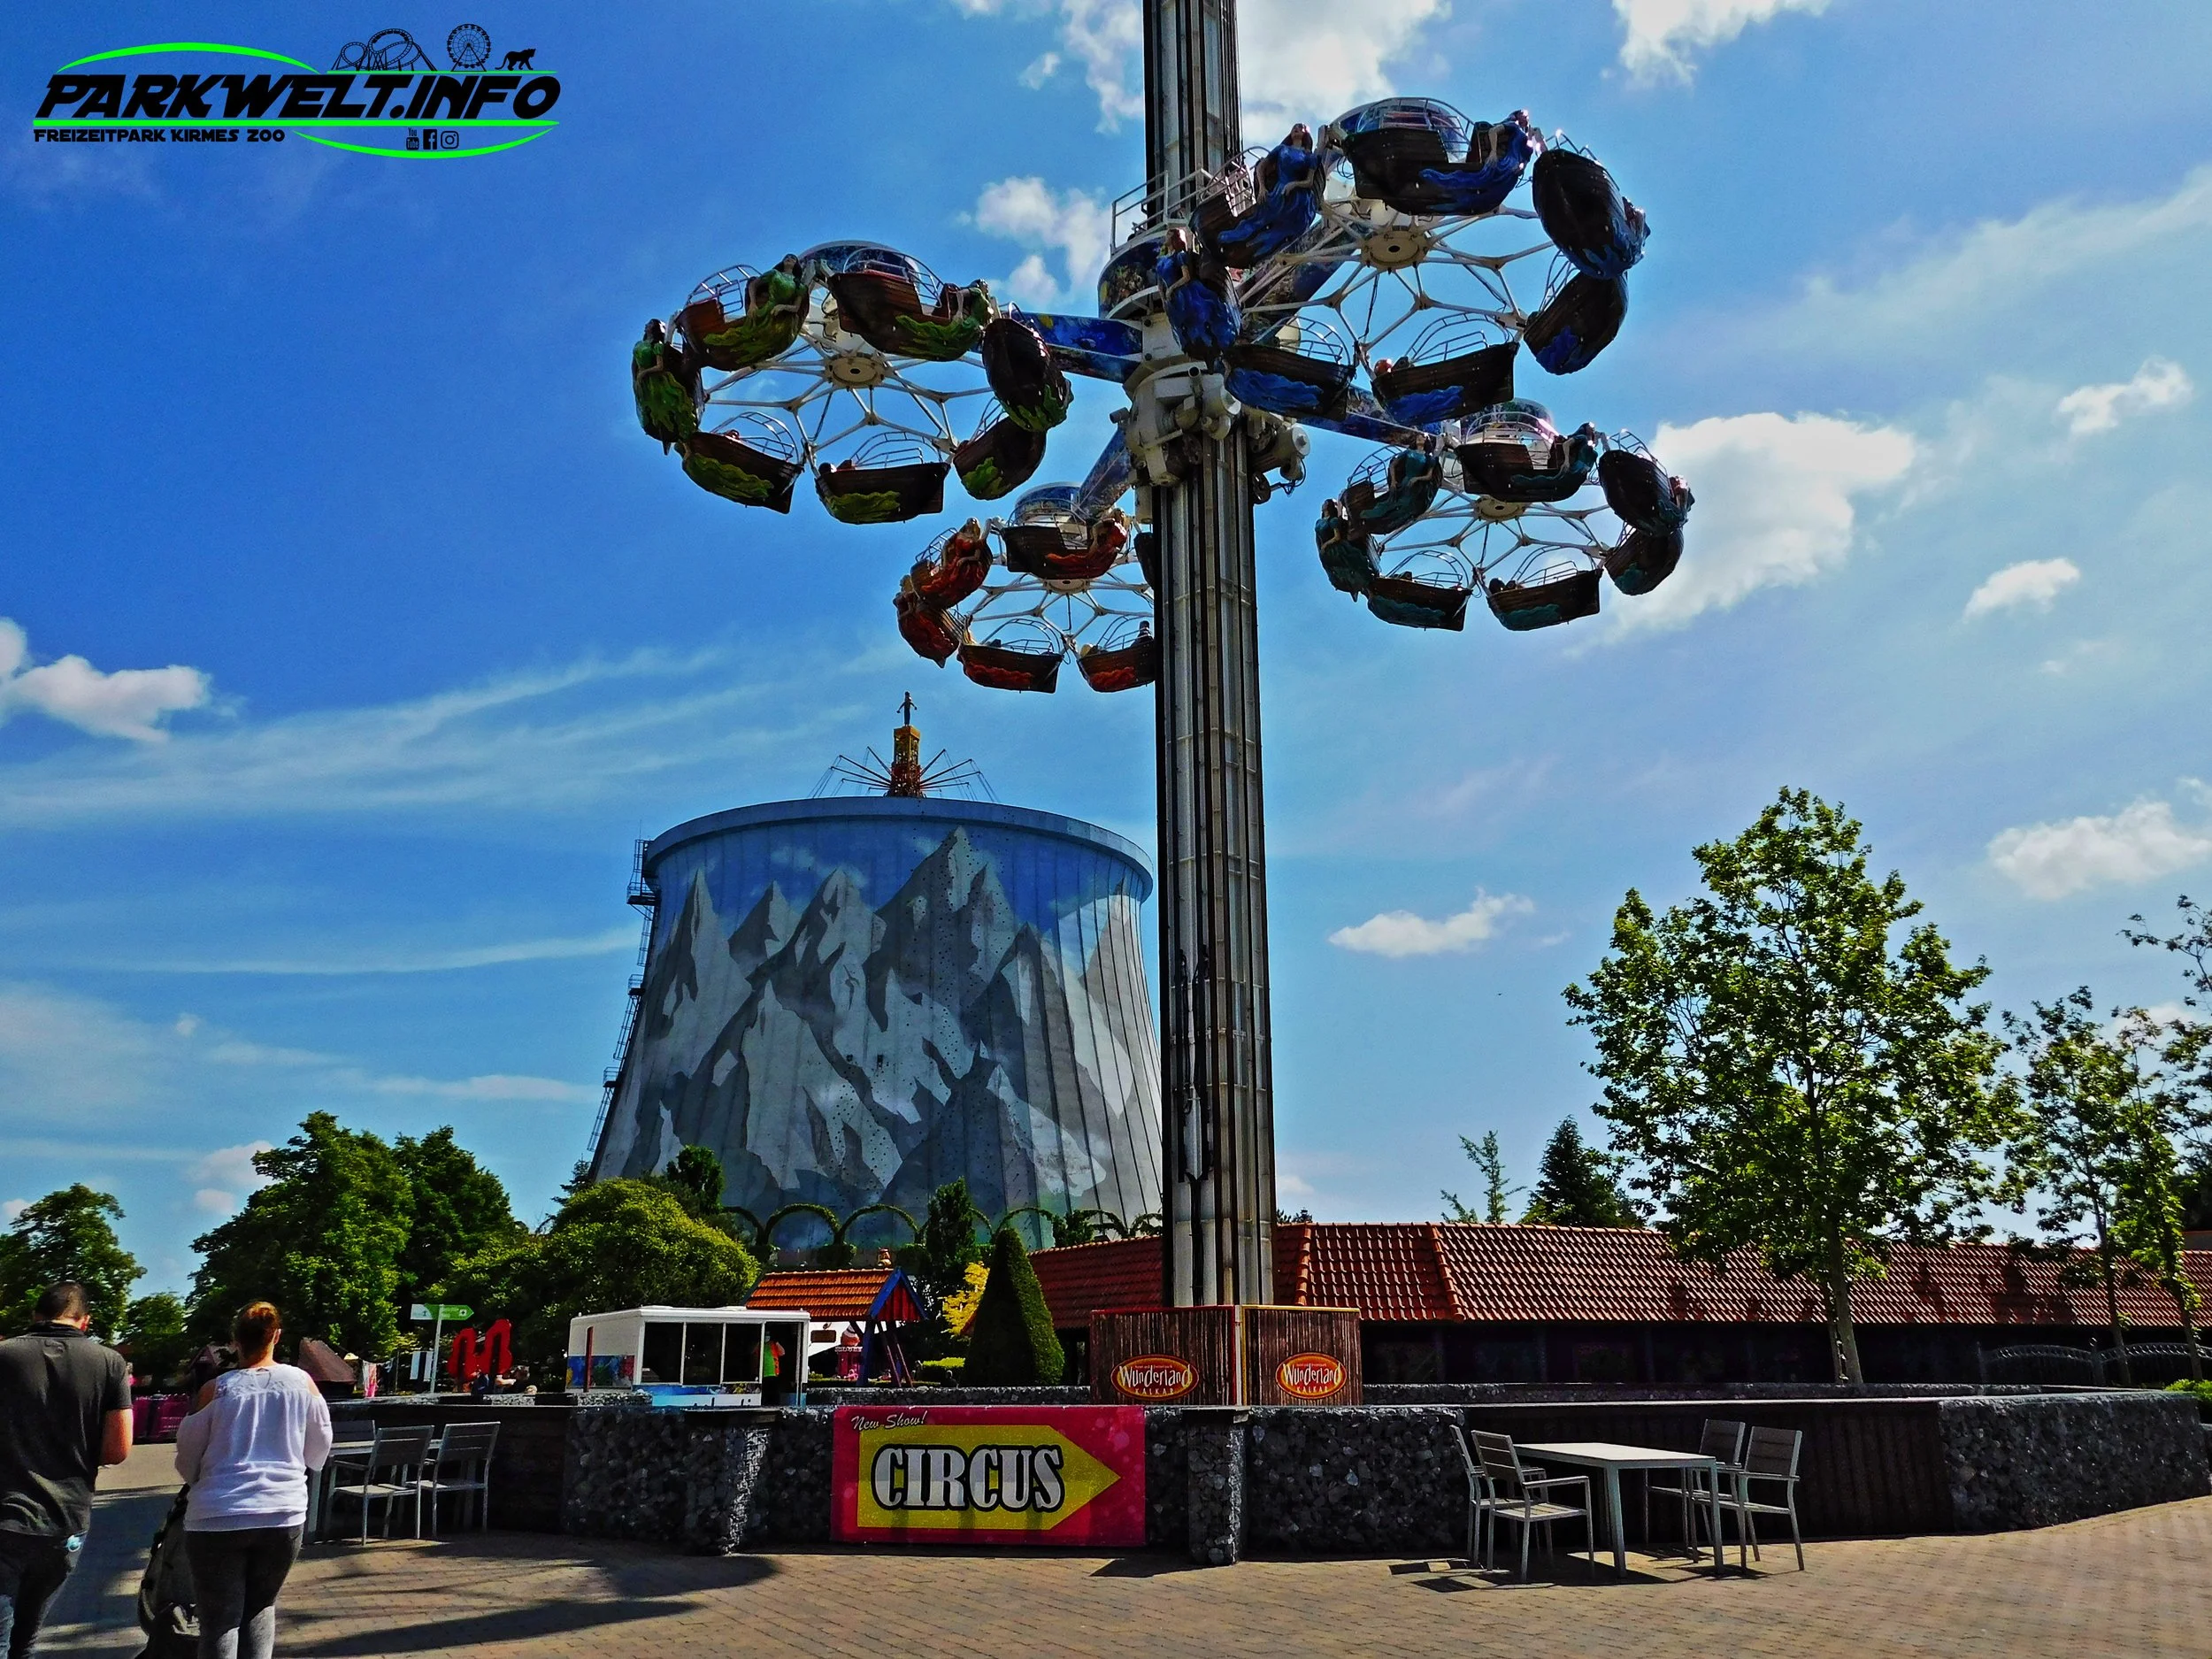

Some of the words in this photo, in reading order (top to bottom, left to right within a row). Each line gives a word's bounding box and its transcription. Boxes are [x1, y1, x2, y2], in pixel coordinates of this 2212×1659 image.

[1119, 1363, 1191, 1388] Wunderland
[1283, 1362, 1341, 1386] Wunderland
[851, 1416, 879, 1431] New
[885, 1410, 928, 1428] Show!
[872, 1444, 1065, 1511] CIRCUS
